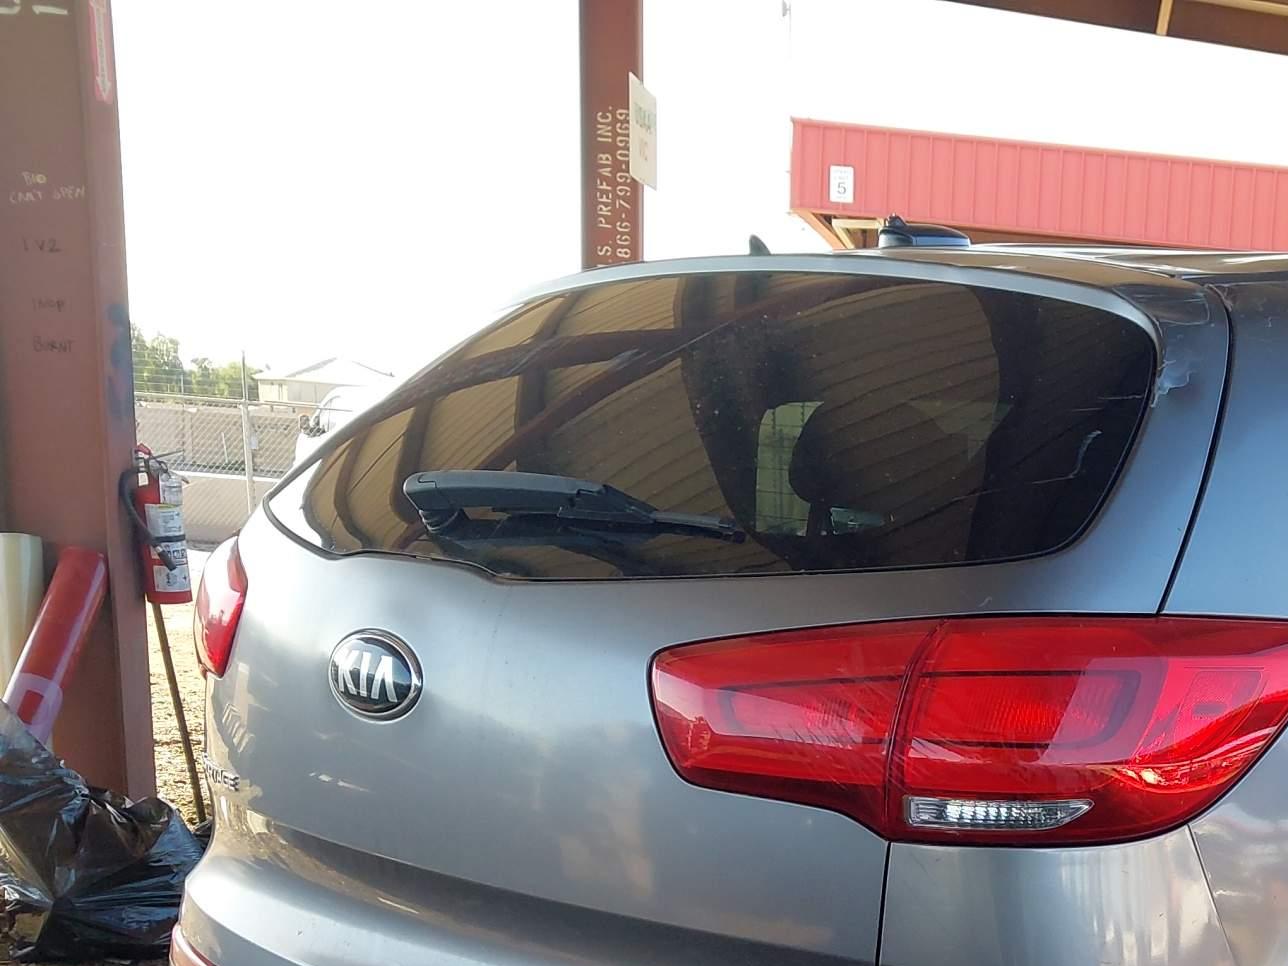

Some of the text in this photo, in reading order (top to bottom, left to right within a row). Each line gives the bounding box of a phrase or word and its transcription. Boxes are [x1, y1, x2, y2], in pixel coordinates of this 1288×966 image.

[596, 105, 612, 143] INC.
[596, 153, 612, 229] PREFAB
[836, 181, 847, 195] 5
[335, 647, 398, 703] KIA
